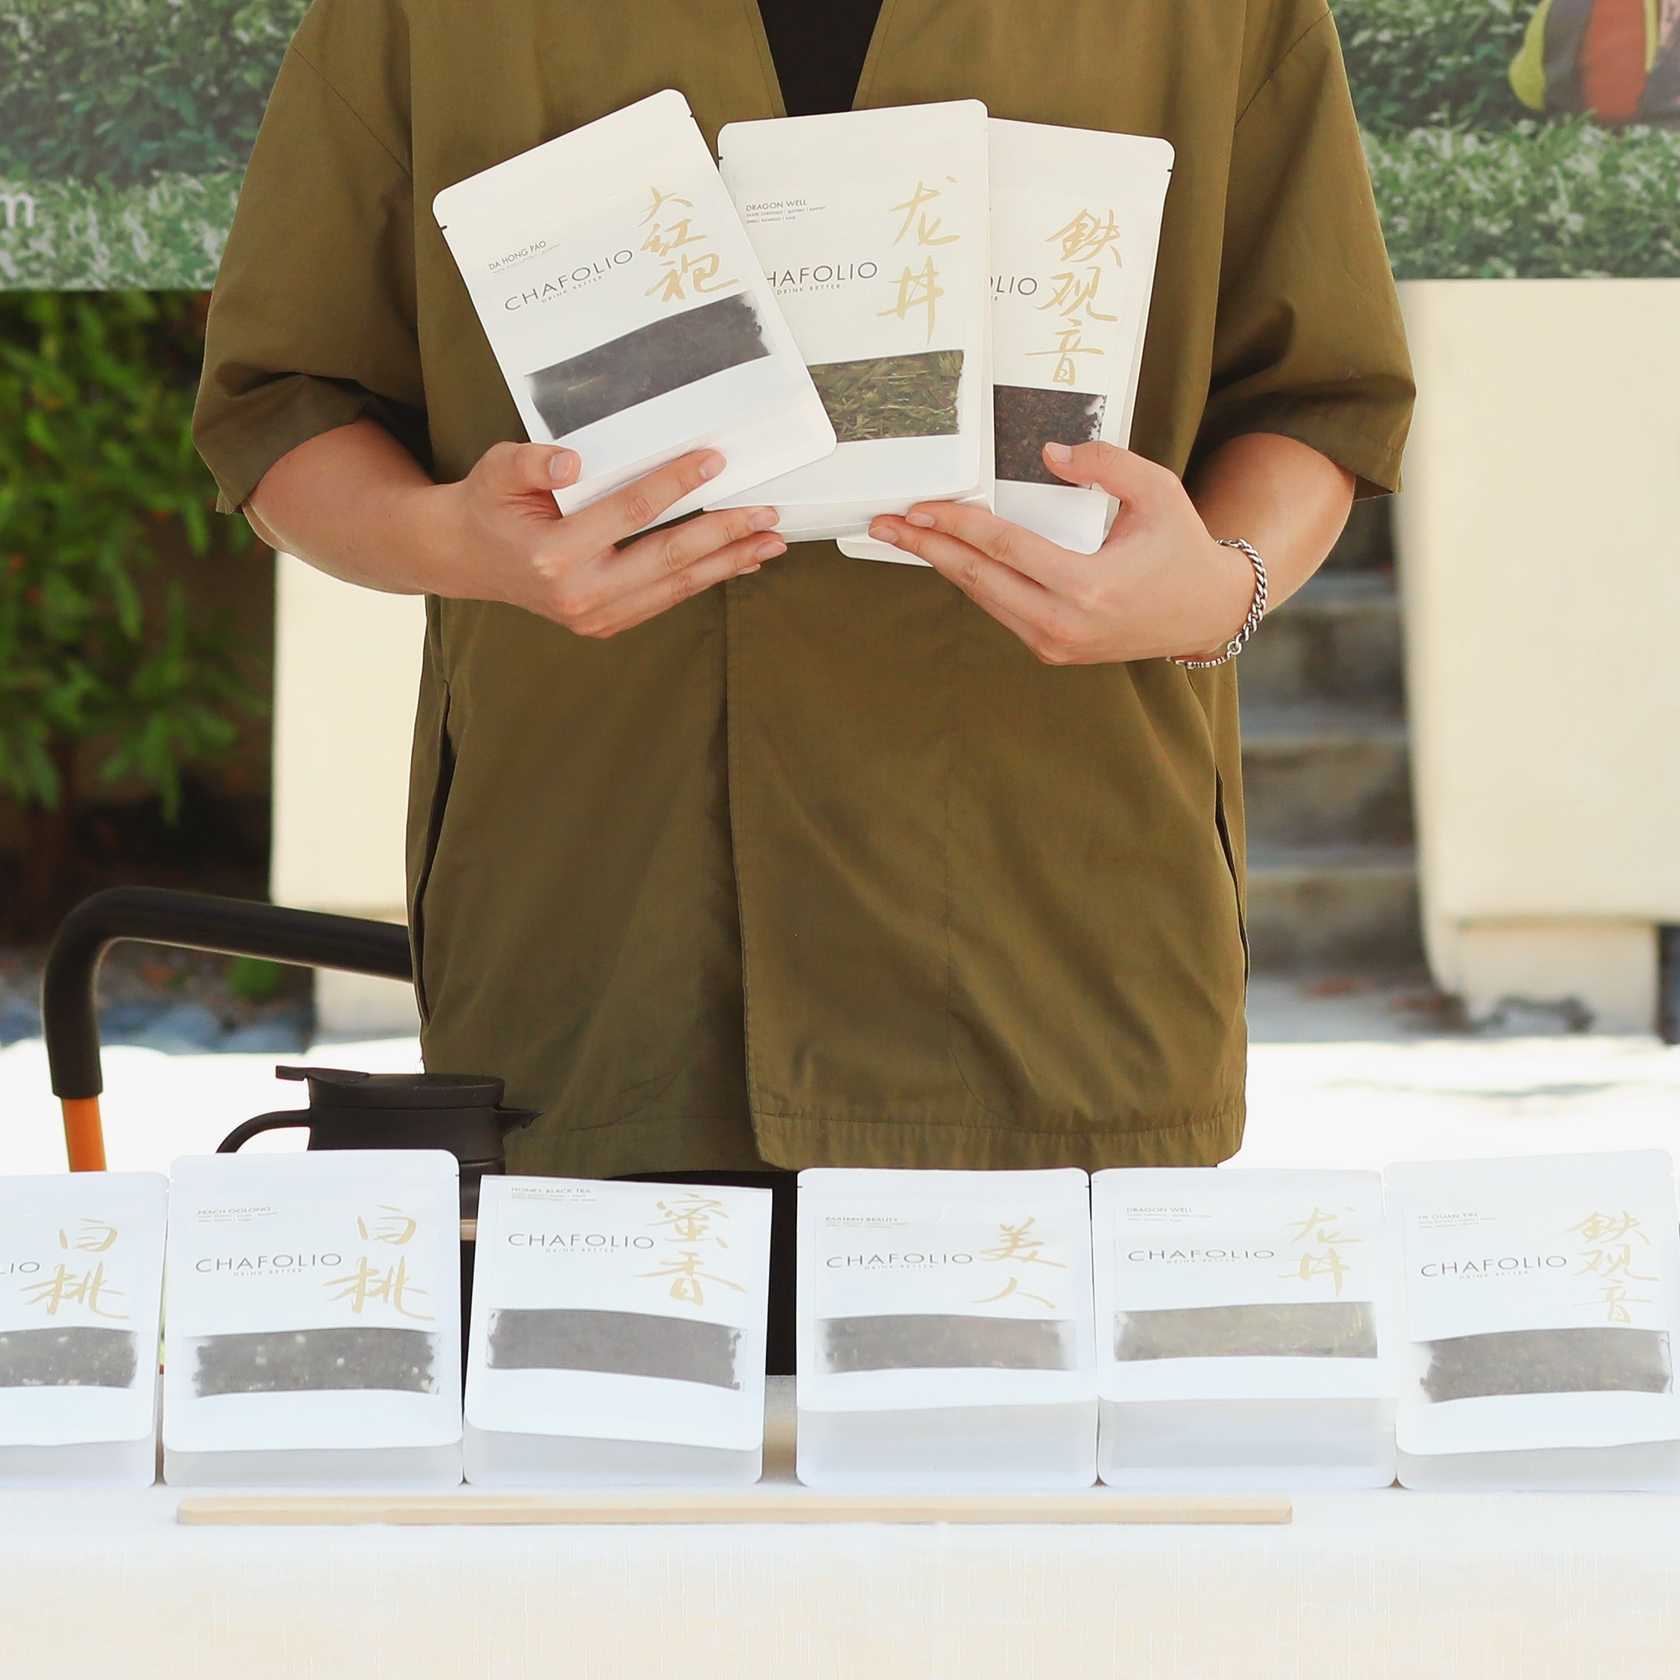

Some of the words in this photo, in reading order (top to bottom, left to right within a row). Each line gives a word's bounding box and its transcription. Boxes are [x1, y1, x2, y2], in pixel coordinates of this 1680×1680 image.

[504, 249, 633, 311] CHAFOLIO
[766, 261, 878, 288] HAFOLIO
[508, 1232, 655, 1250] CHAFOLIO
[195, 1252, 342, 1273] CHAFOLIO
[826, 1252, 974, 1269] CHAFOLIO
[1128, 1249, 1275, 1263] CHAFOLIO
[1420, 1255, 1568, 1278] CHAFOLIO
